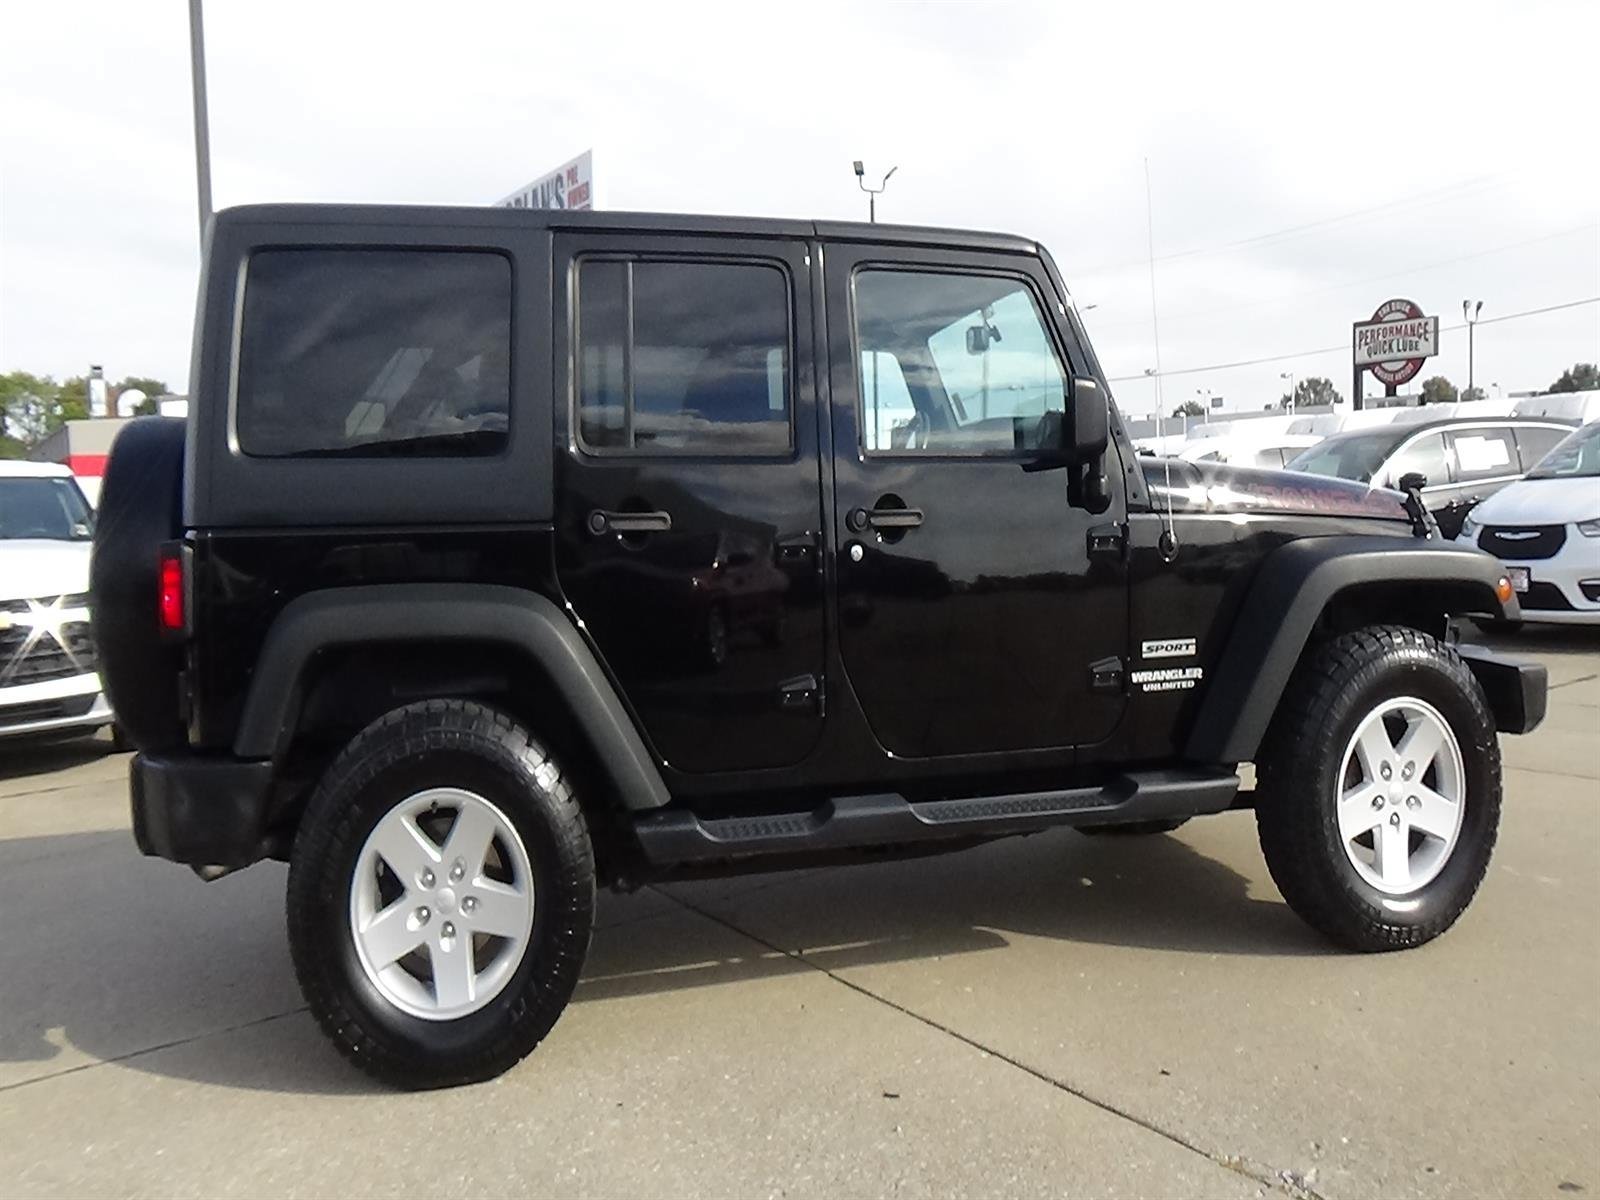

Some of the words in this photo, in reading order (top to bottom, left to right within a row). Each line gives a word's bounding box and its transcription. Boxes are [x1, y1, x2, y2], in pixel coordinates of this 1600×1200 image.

[1358, 321, 1429, 350] PERFORMANCE
[1366, 339, 1394, 358] QUICK
[1397, 338, 1420, 353] LUBE
[1145, 643, 1192, 654] SPORT
[1131, 667, 1203, 683] WRANGLER
[1142, 680, 1195, 692] UNLIMITED
